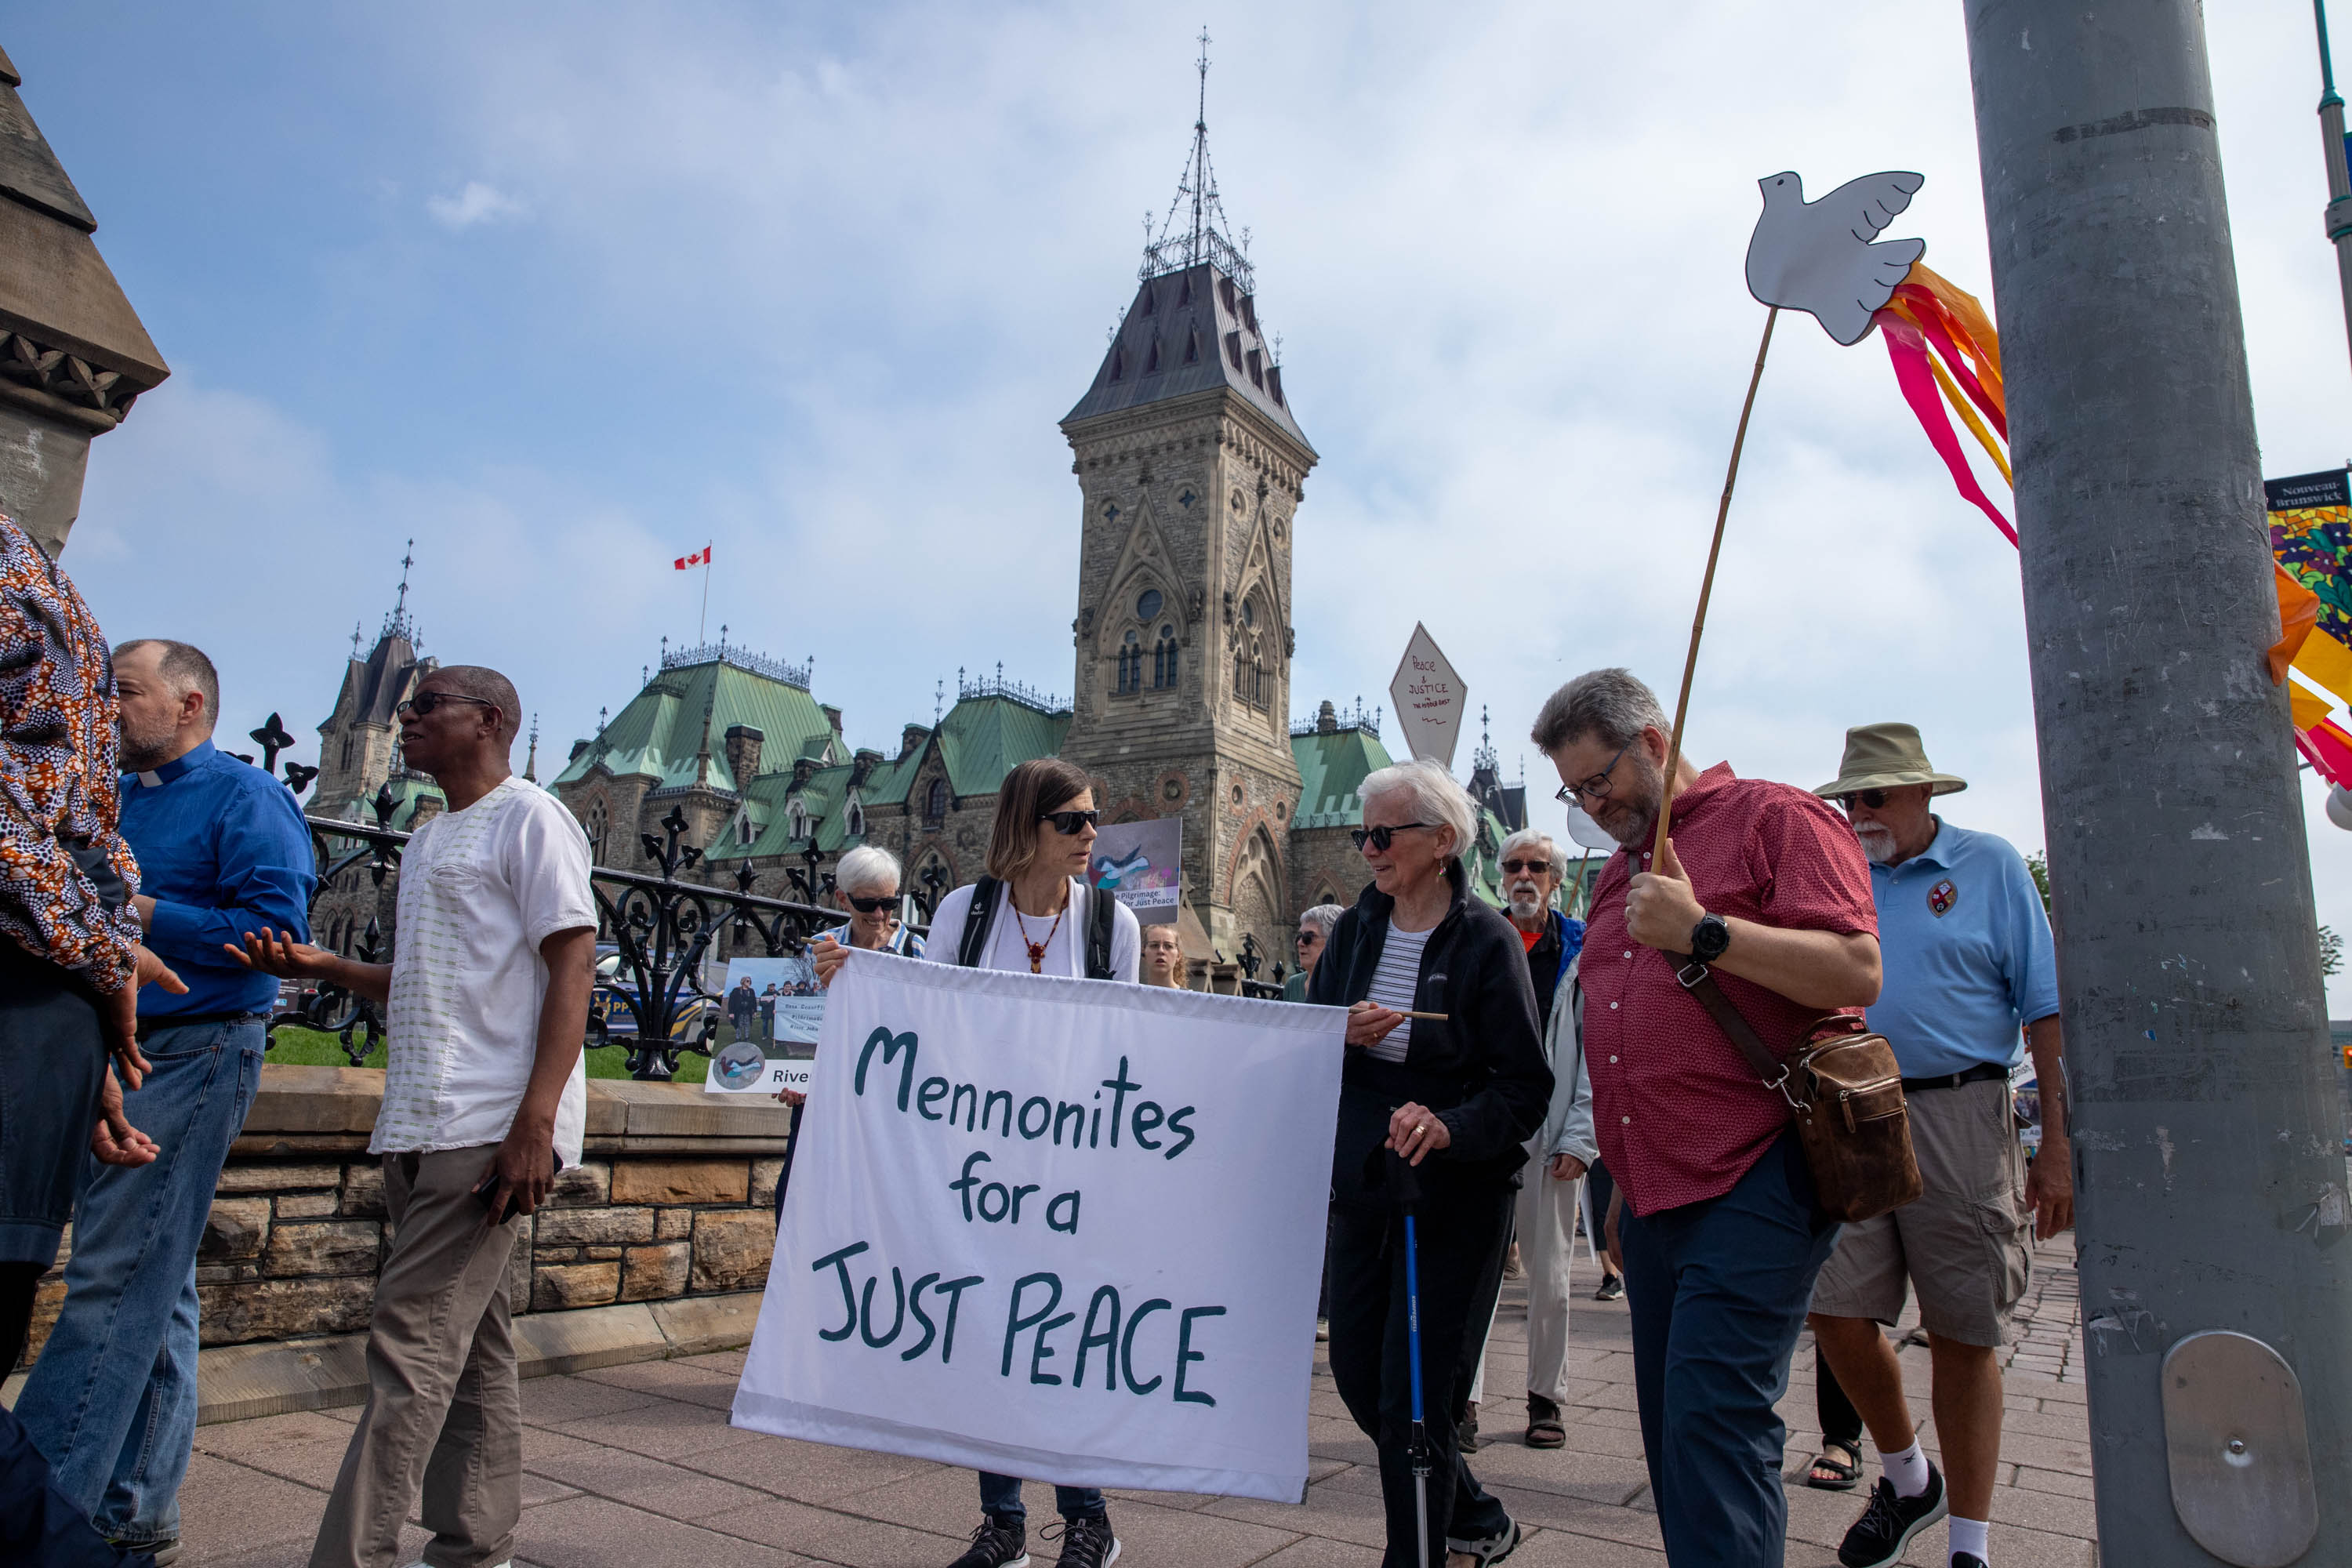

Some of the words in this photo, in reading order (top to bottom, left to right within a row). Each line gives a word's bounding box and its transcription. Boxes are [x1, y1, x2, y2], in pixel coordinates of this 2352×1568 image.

[2283, 482, 2340, 495] Nouveau-
[2276, 492, 2343, 507] Brunswick
[1413, 655, 1436, 671] Peace
[1409, 684, 1448, 694] JUSTICE
[1121, 891, 1160, 900] Pilgrimage:
[773, 1069, 809, 1083] Rive
[855, 1026, 1196, 1160] Mennonites
[949, 1151, 1040, 1225] for
[1046, 1189, 1080, 1235] a
[812, 1241, 984, 1364] JUST
[1000, 1272, 1227, 1408] PEACE
